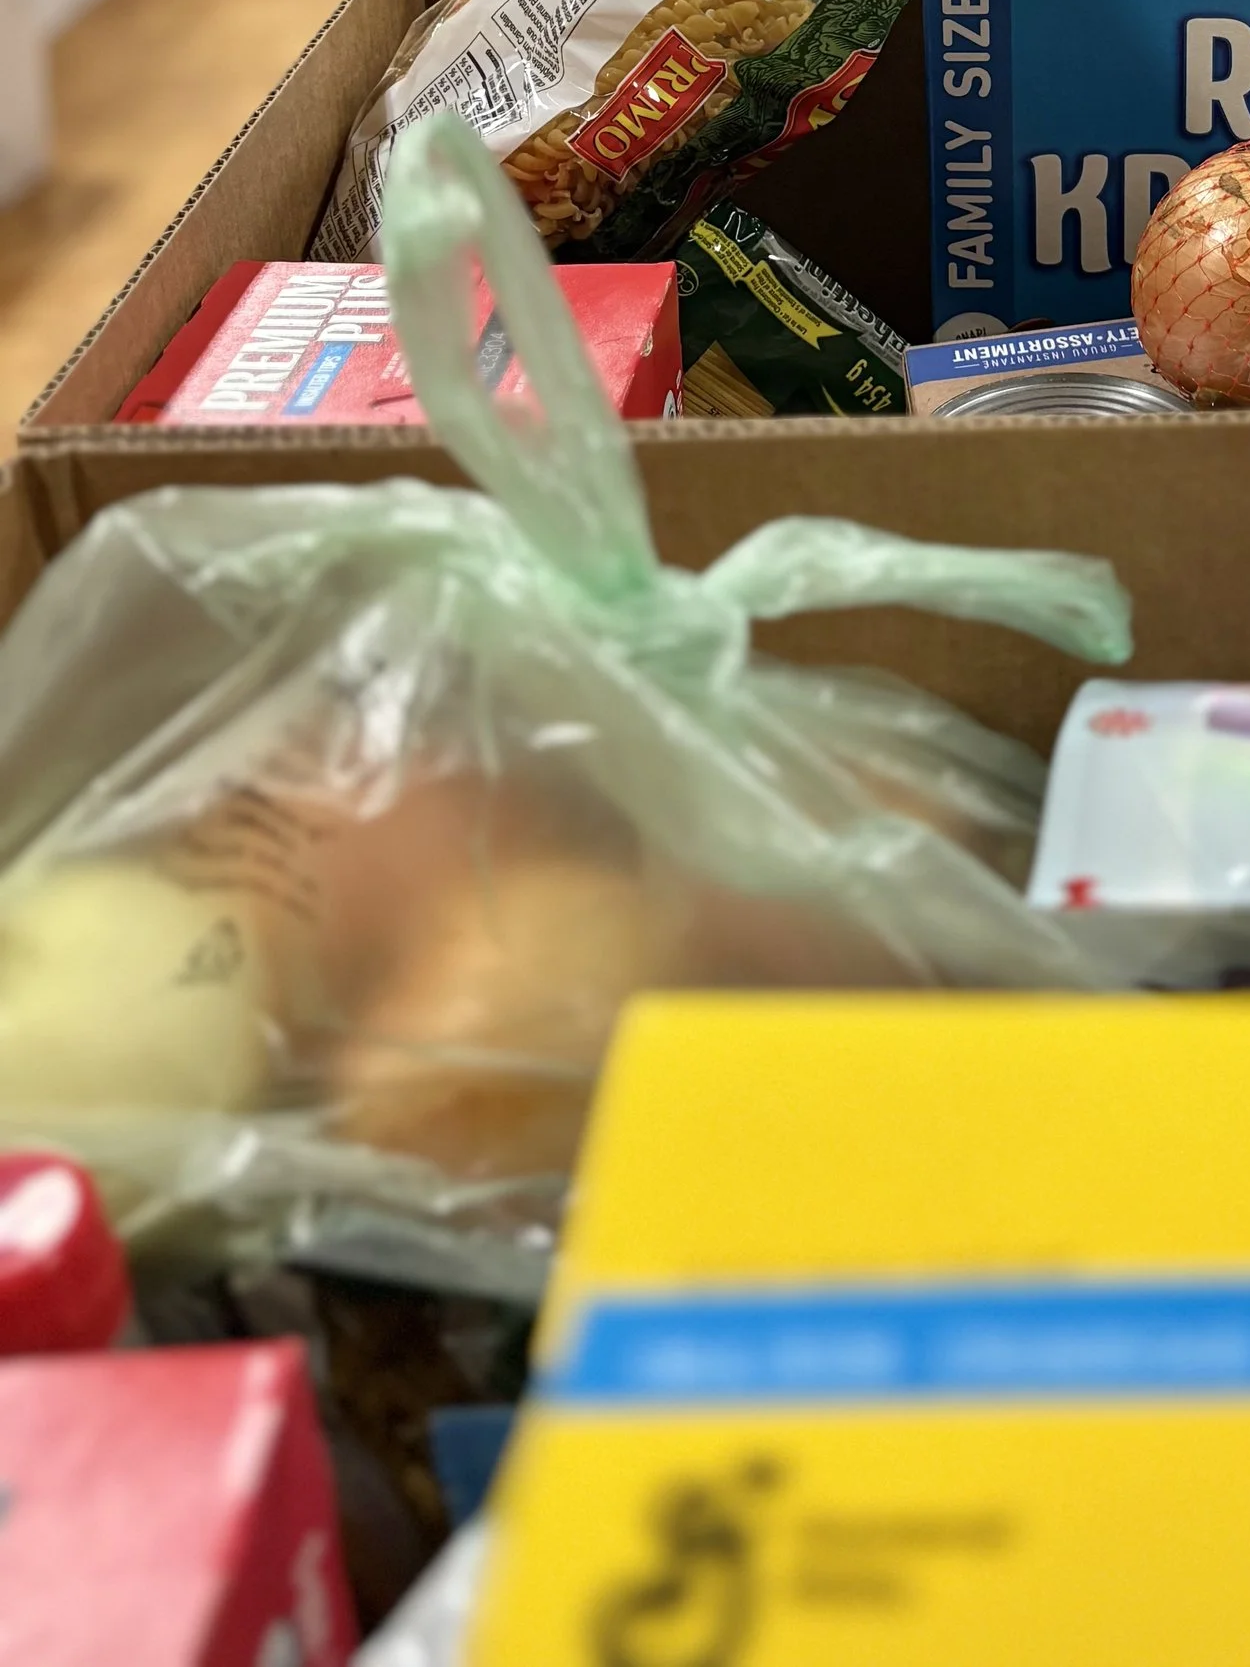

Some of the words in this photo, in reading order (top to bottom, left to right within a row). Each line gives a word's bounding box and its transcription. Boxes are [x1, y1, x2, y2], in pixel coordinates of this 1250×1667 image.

[499, 11, 525, 45] Canadian
[594, 43, 709, 159] PRIMO
[945, 119, 994, 290] FAMILY
[318, 274, 388, 344] PLUS
[767, 288, 783, 305] Source
[804, 310, 821, 328] Source
[199, 274, 352, 412] PREMIUM
[952, 332, 1094, 363] ASSORTIMENT
[983, 349, 1065, 369] INSTANTANÉ
[1072, 343, 1117, 359] GRUAU
[845, 358, 869, 382] g
[853, 376, 892, 412] 454
